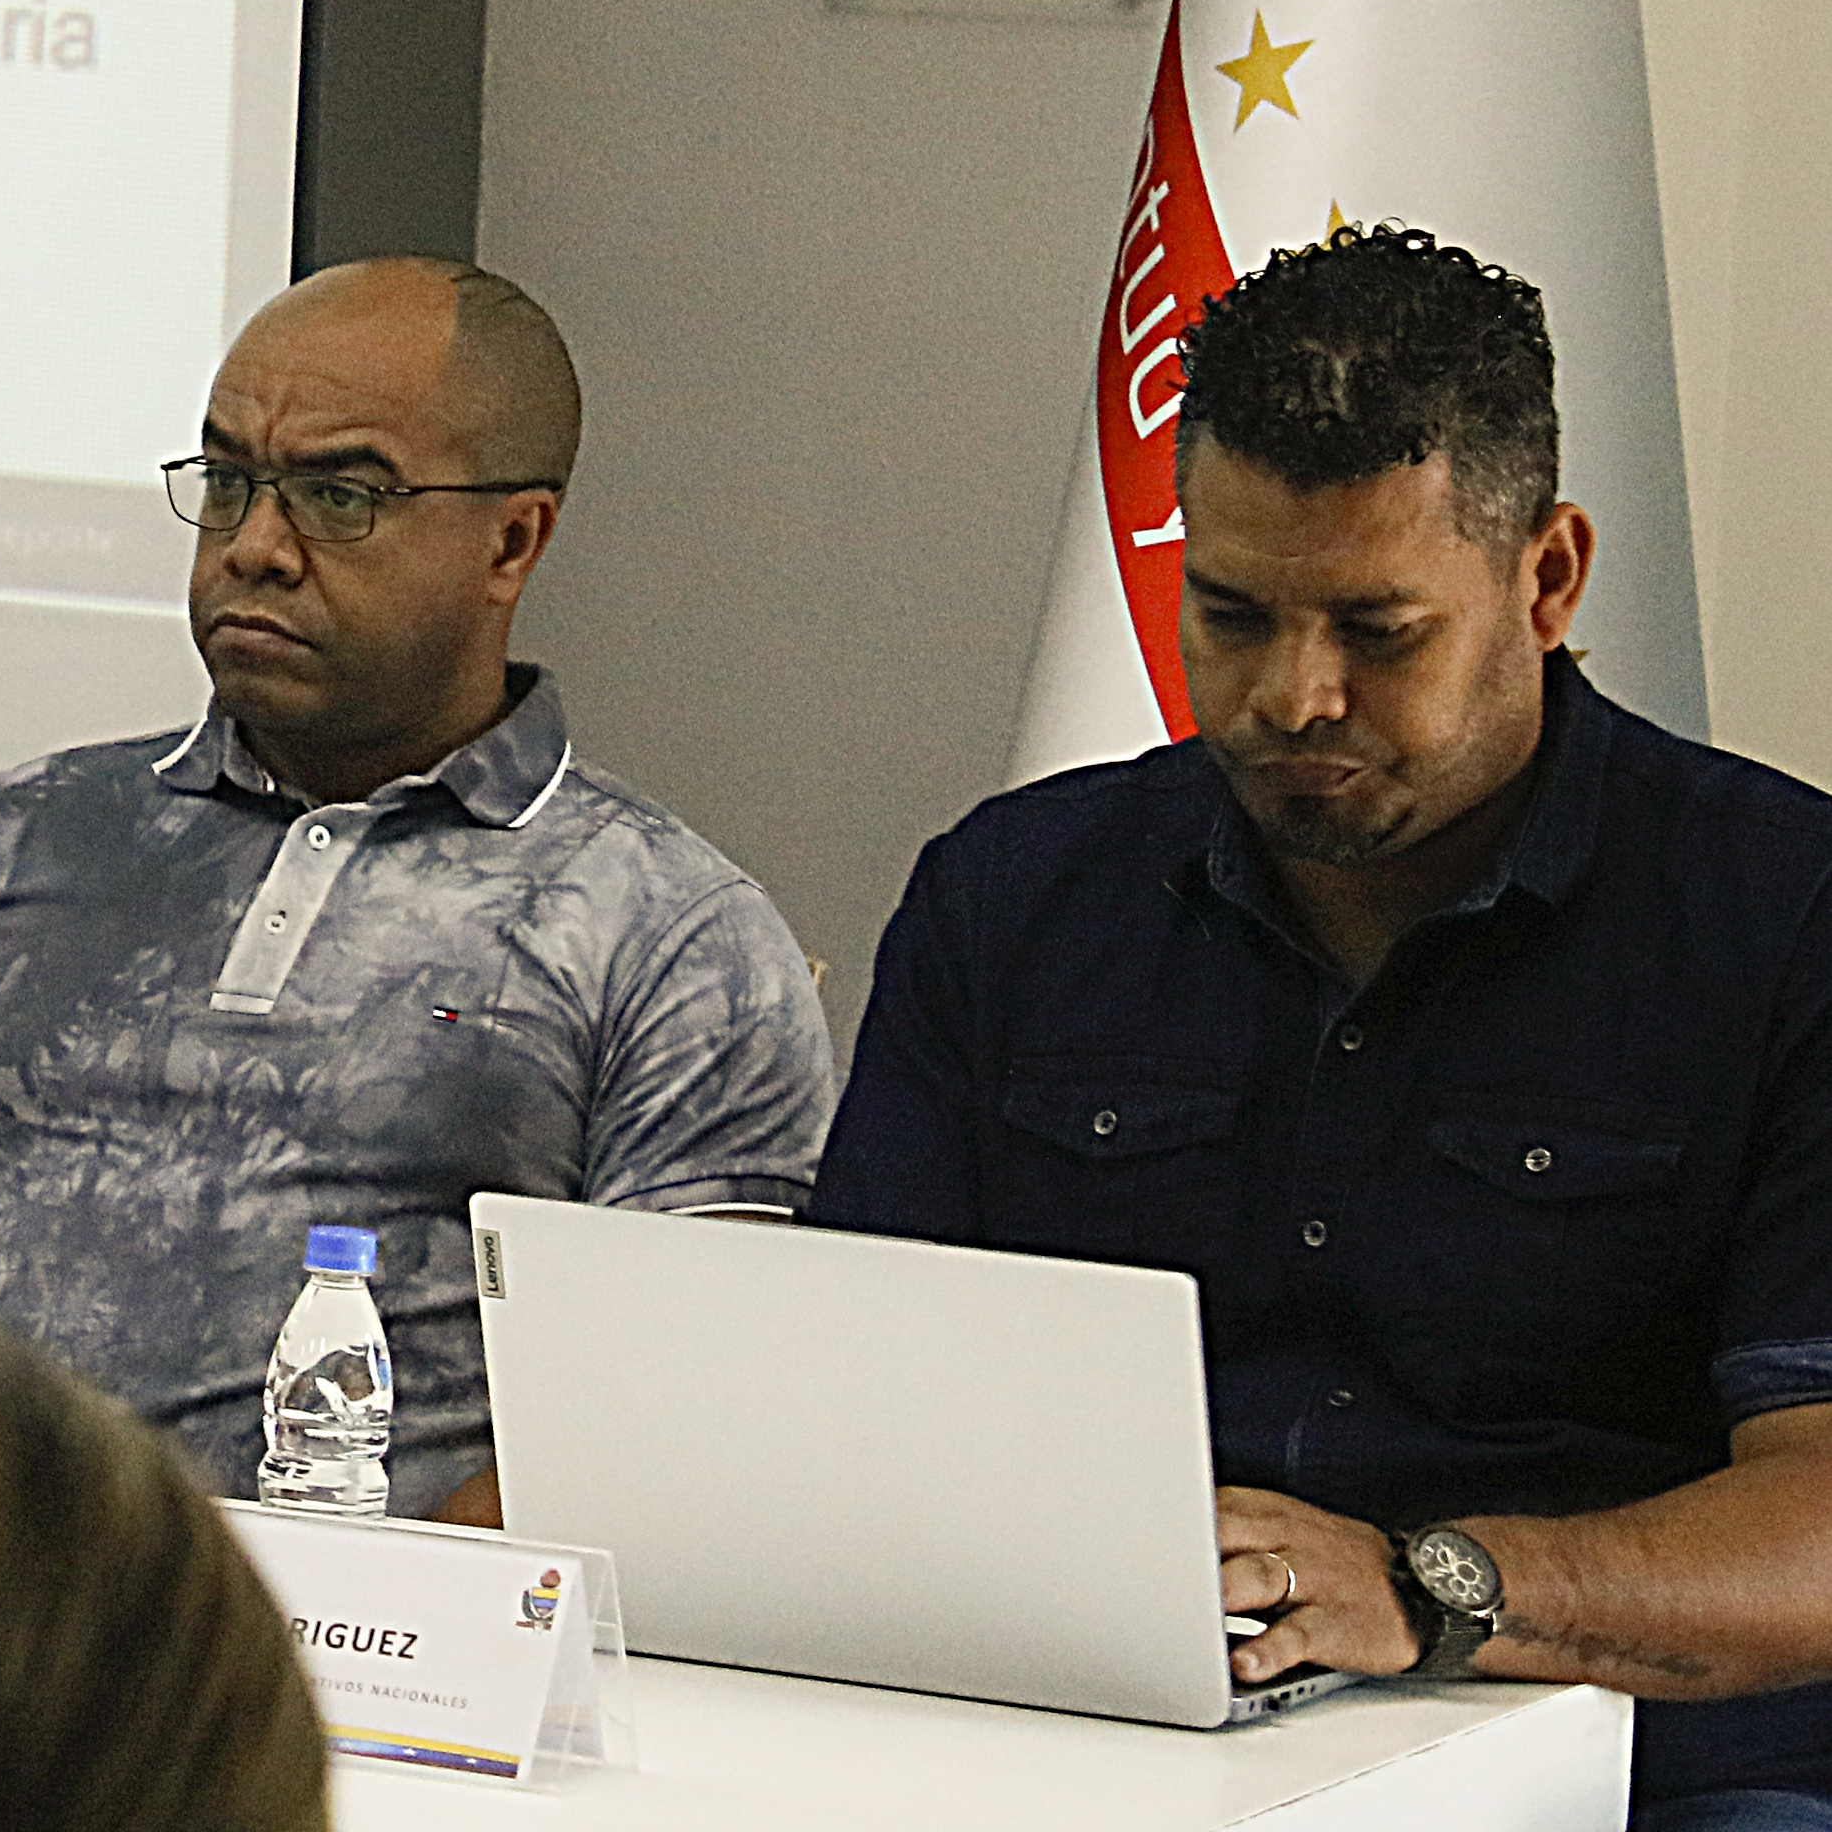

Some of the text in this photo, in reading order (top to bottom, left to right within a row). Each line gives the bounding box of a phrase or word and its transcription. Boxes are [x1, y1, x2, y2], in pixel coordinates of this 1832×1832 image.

[484, 1236, 499, 1291] Lenovo
[290, 1618, 419, 1660] RIGUEZ
[370, 1684, 469, 1710] NACIONALES
